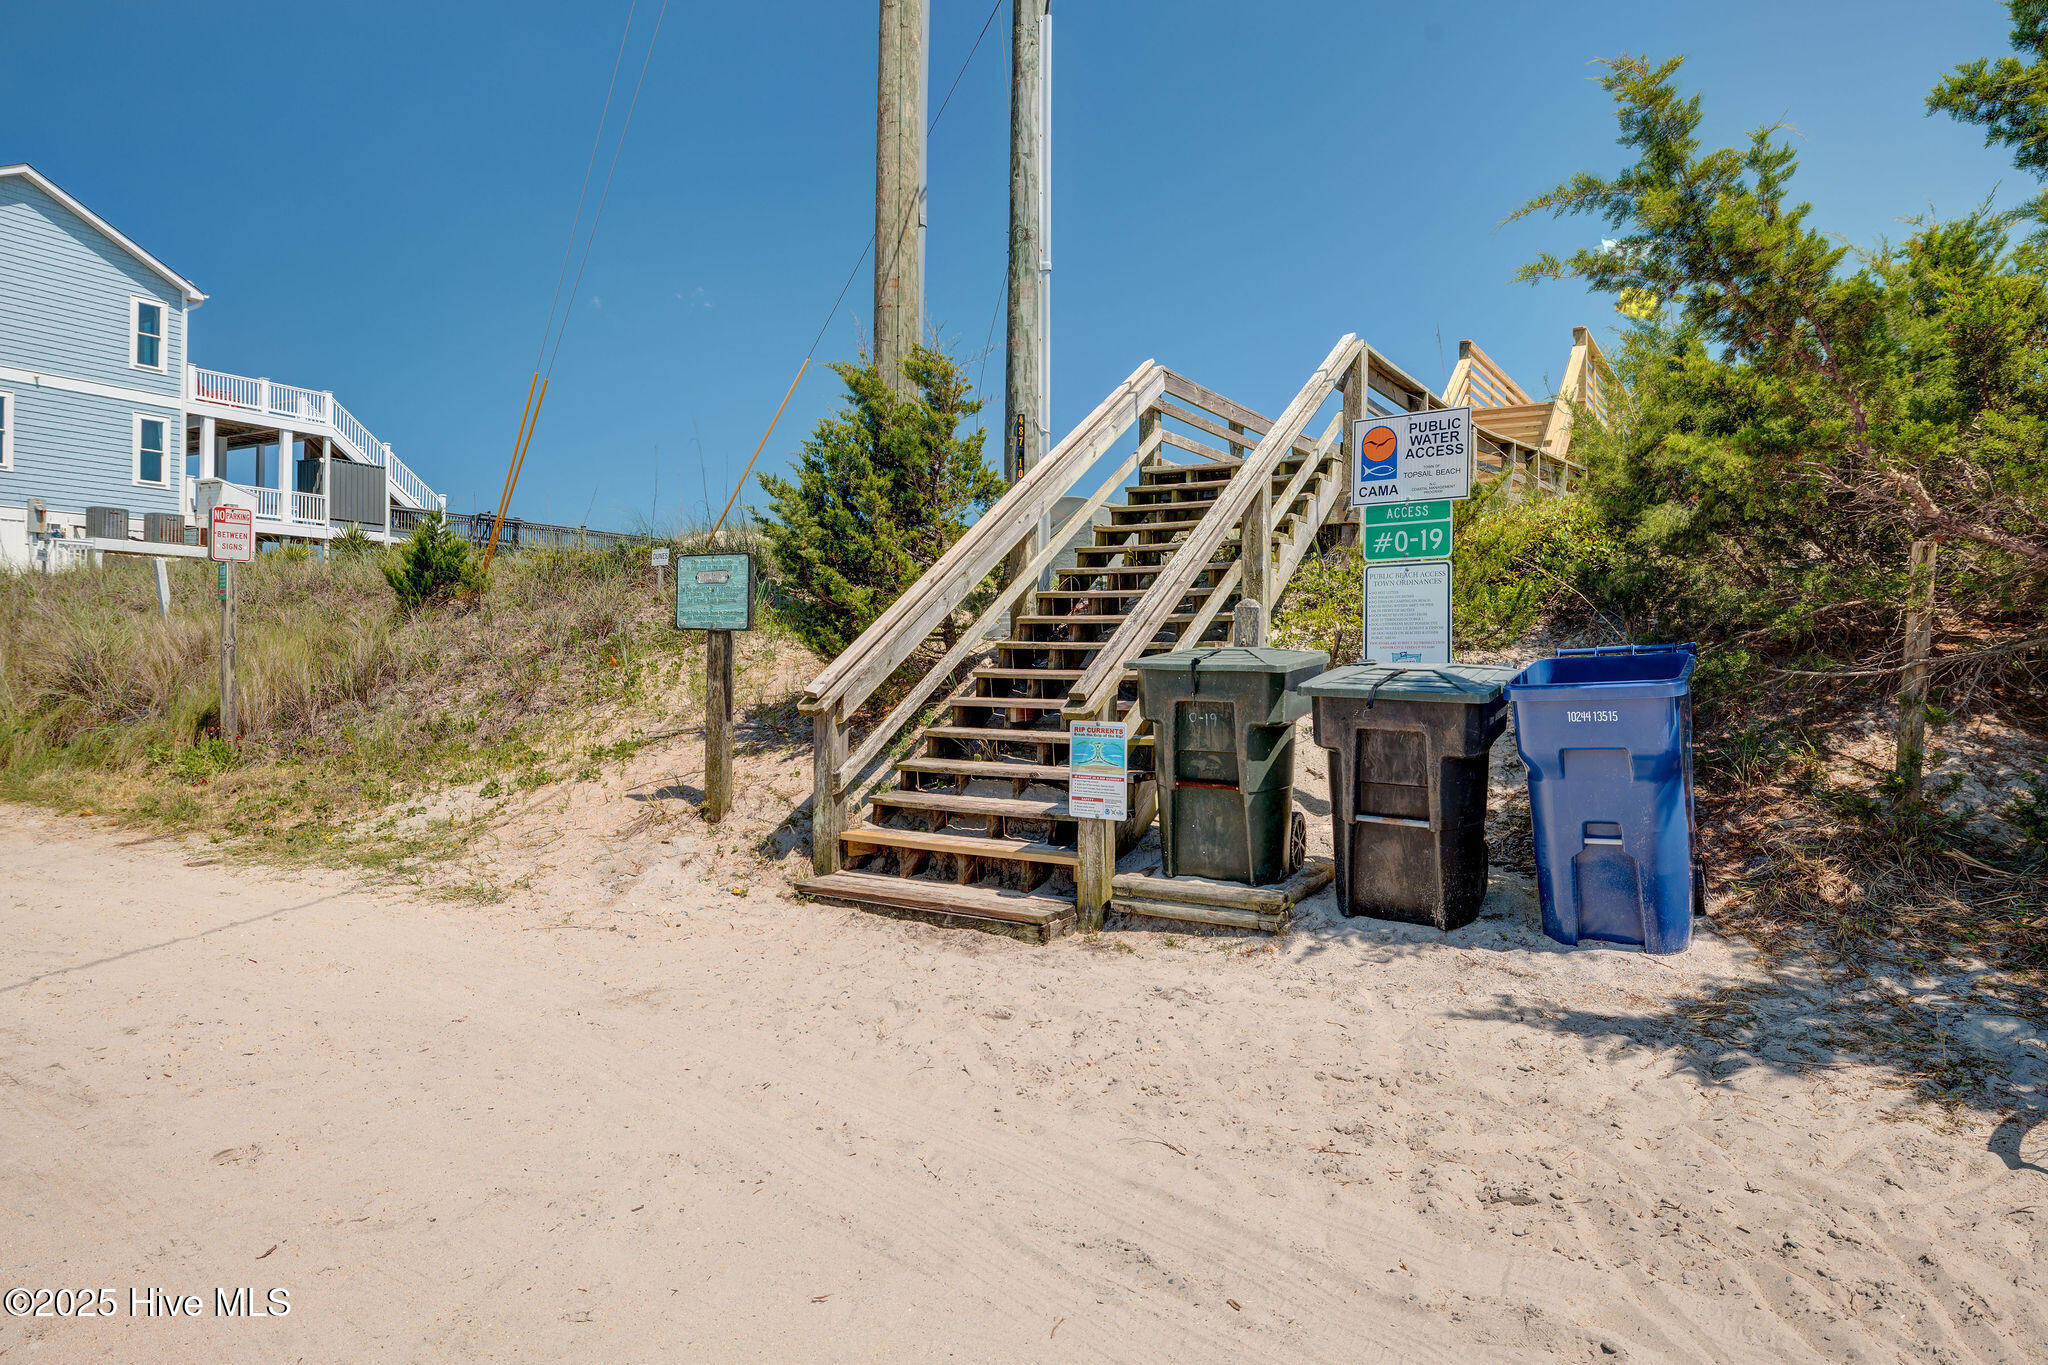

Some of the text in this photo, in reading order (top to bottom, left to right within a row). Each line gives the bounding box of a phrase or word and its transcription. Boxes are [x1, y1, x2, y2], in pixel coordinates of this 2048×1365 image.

[1409, 418, 1461, 434] PUBLIC
[1410, 430, 1460, 446] WATER
[1405, 443, 1464, 460] ACCESS
[1403, 467, 1461, 479] TOPSAIL BEACH
[1359, 484, 1399, 498] CAMA
[214, 510, 250, 521] NO PARKING
[1386, 505, 1429, 519] ACCESS
[217, 530, 248, 540] BETWEEN
[1373, 528, 1443, 553] #0-19
[221, 543, 243, 551] SIGNS
[1395, 571, 1419, 579] BEACH
[1420, 570, 1447, 578] ACCESS
[1396, 578, 1442, 586] ORDINANCES
[1566, 710, 1618, 722] 10244 13515
